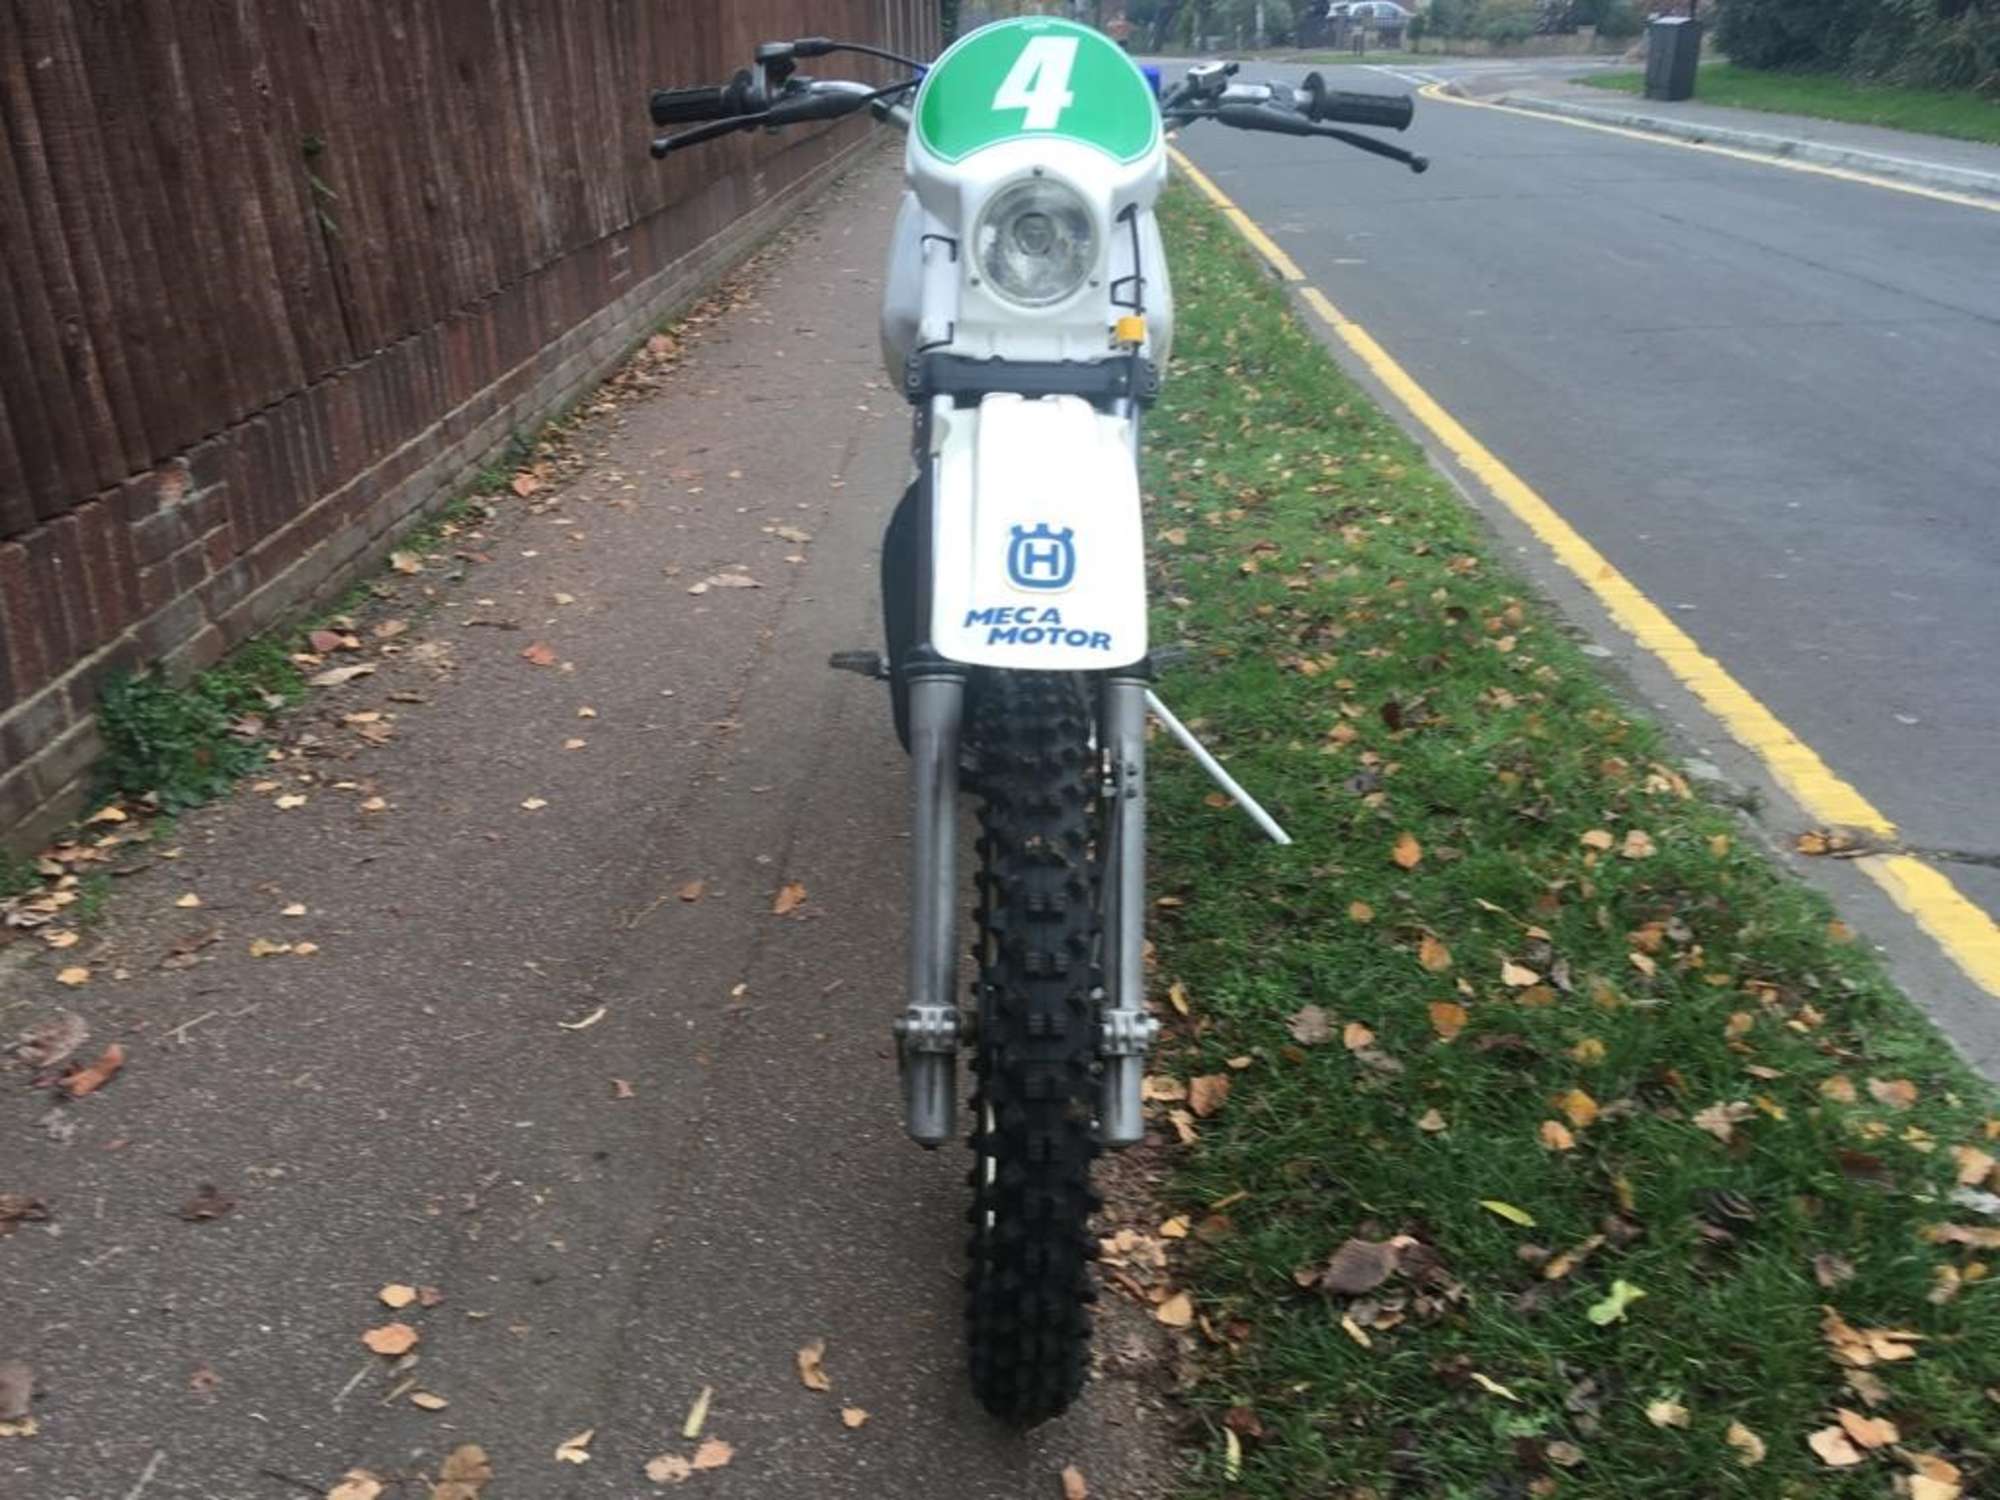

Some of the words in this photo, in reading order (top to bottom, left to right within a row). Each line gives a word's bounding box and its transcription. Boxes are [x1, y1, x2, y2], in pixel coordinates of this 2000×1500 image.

[991, 36, 1079, 129] 4
[1024, 542, 1059, 576] H
[963, 606, 1061, 628] MECA
[987, 626, 1112, 651] MOTOR
